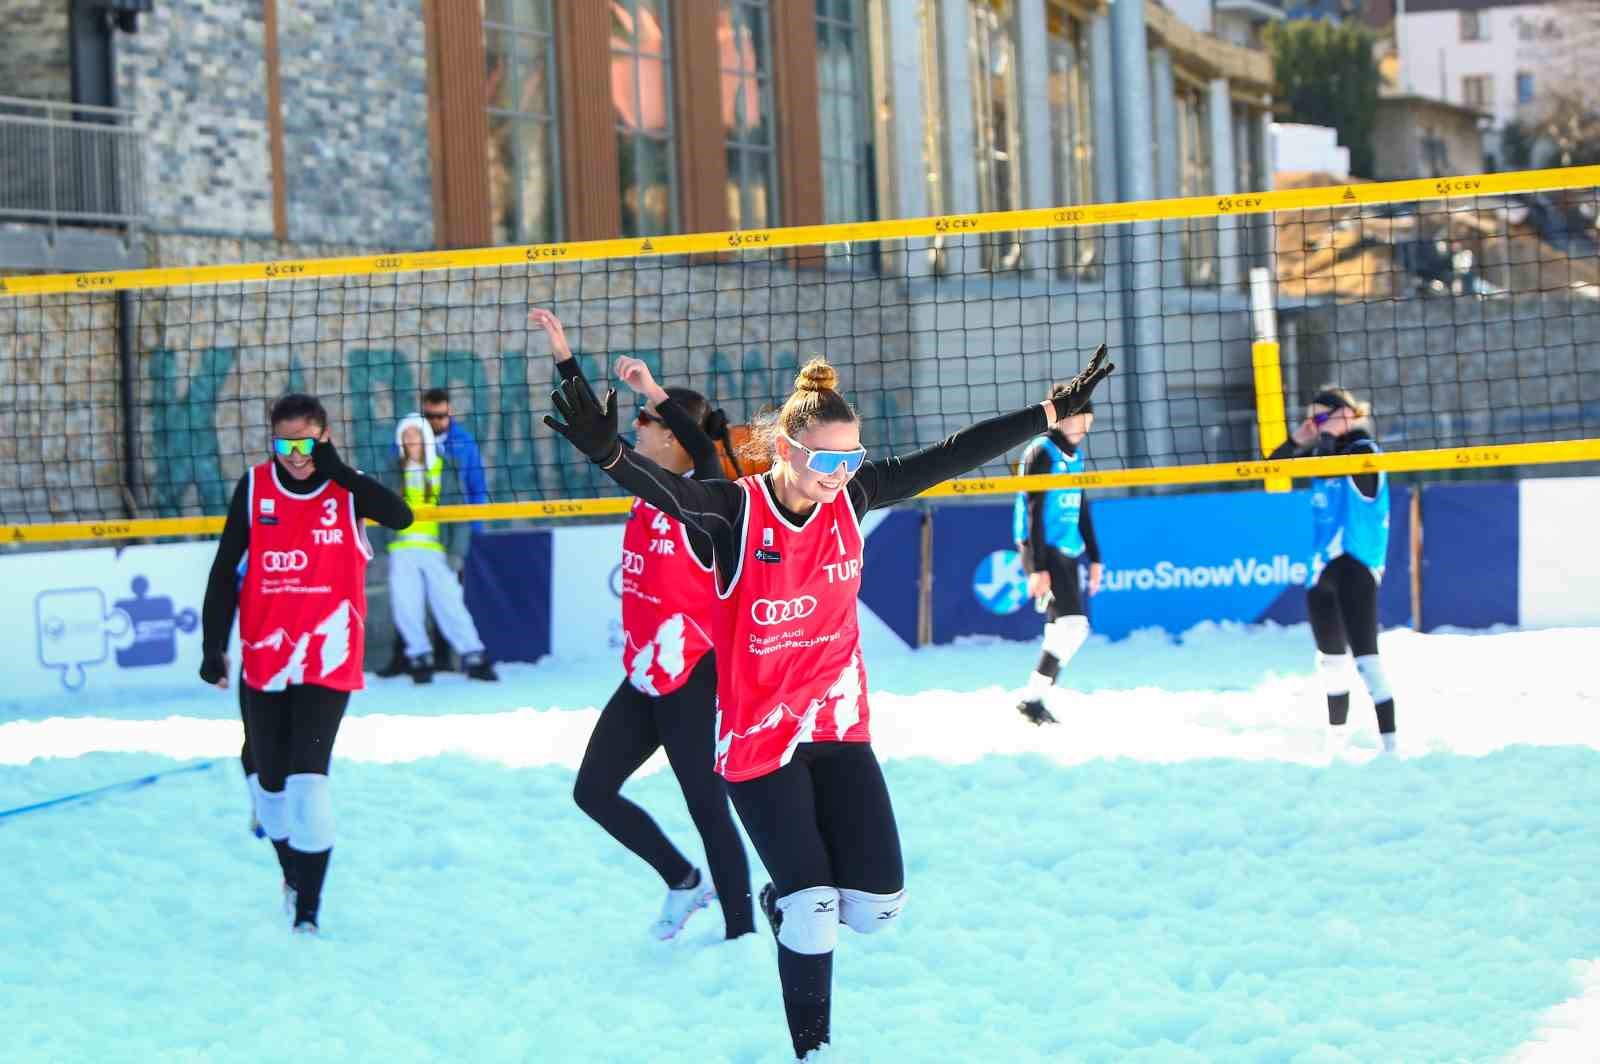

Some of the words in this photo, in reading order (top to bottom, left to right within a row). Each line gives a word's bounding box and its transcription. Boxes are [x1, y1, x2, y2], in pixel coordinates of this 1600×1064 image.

[1236, 198, 1263, 208] CEV
[952, 218, 978, 228] CEV
[745, 233, 769, 242] CEV
[543, 247, 567, 256] CEV
[320, 498, 338, 526] 3
[652, 512, 671, 535] 4
[311, 529, 344, 544] TUR
[830, 519, 847, 556] 1
[822, 559, 860, 584] TUR
[1078, 554, 1308, 592] EuroSnowVolle
[781, 628, 805, 639] Audi
